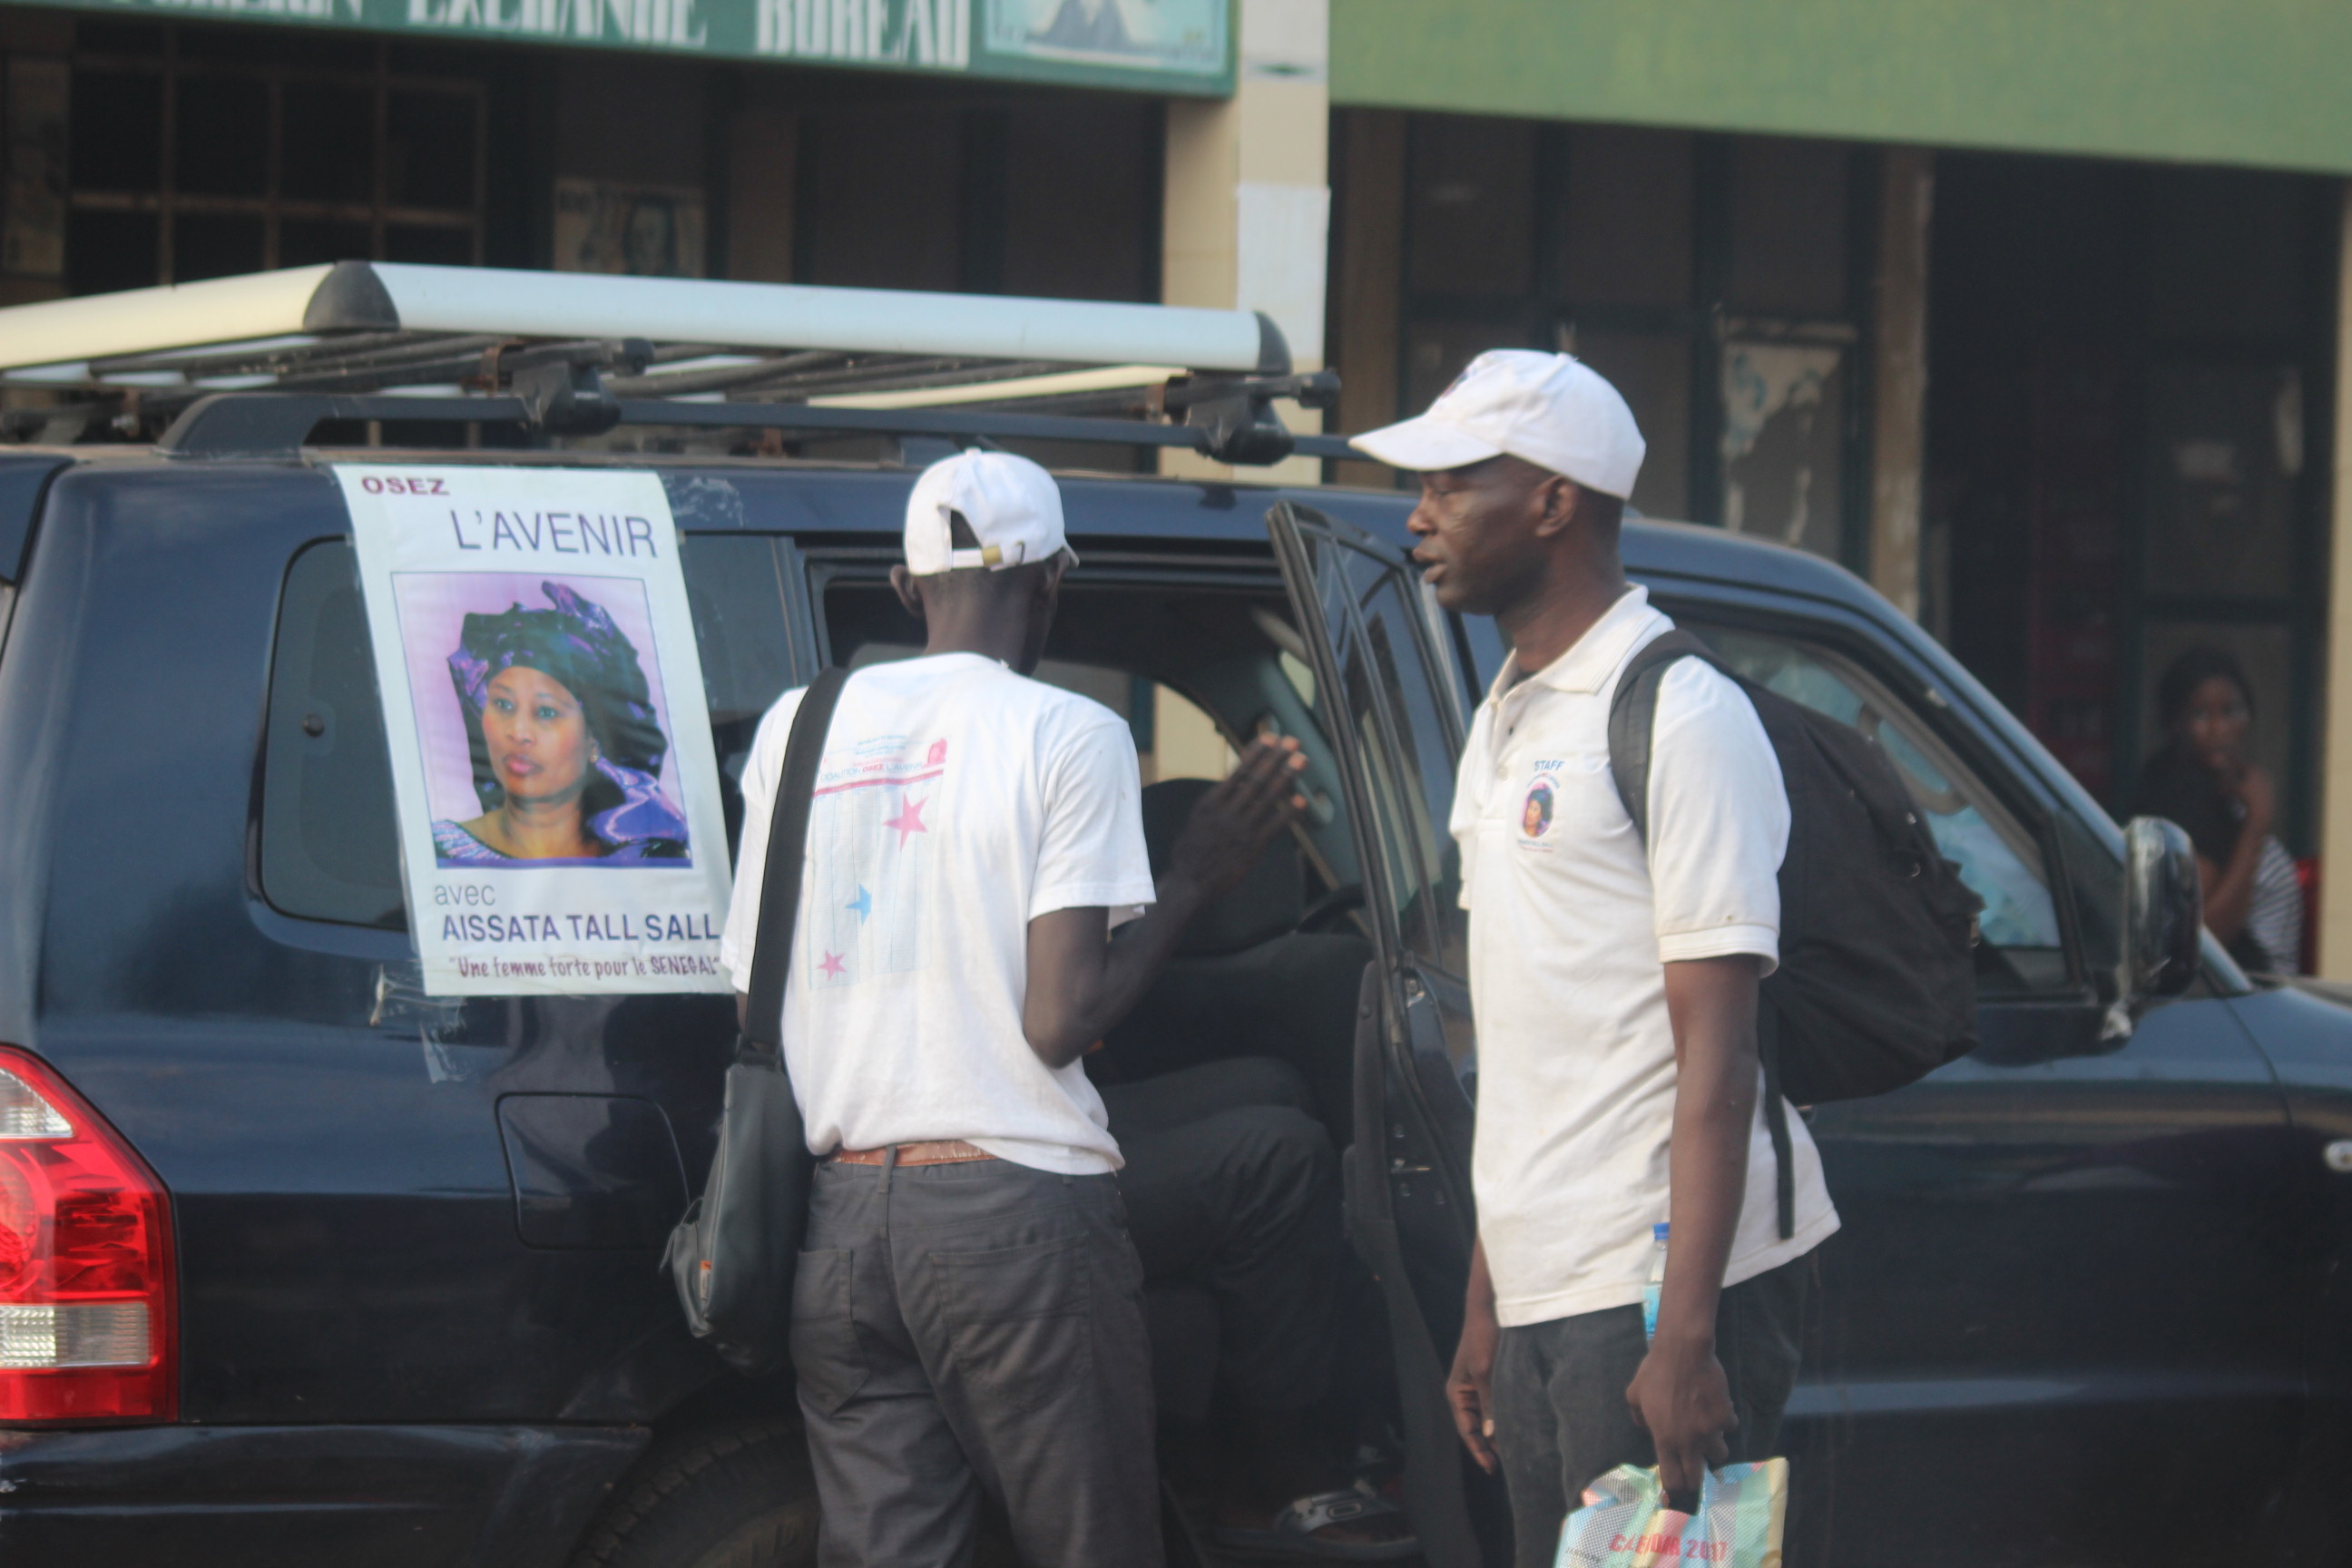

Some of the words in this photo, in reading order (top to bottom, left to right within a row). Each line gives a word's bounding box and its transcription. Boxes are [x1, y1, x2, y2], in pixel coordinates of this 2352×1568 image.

[361, 476, 450, 495] OSEZ
[450, 509, 658, 558] L'AVENIR
[1534, 760, 1565, 772] STAFF
[435, 884, 496, 906] avec
[442, 915, 561, 942] AISSATA
[566, 914, 640, 941] TALL
[644, 913, 720, 941] SALL
[494, 956, 546, 978] femme
[549, 956, 591, 978] forte
[595, 959, 628, 981] pour
[632, 956, 647, 976] le
[1685, 1538, 1729, 1563] 2017
